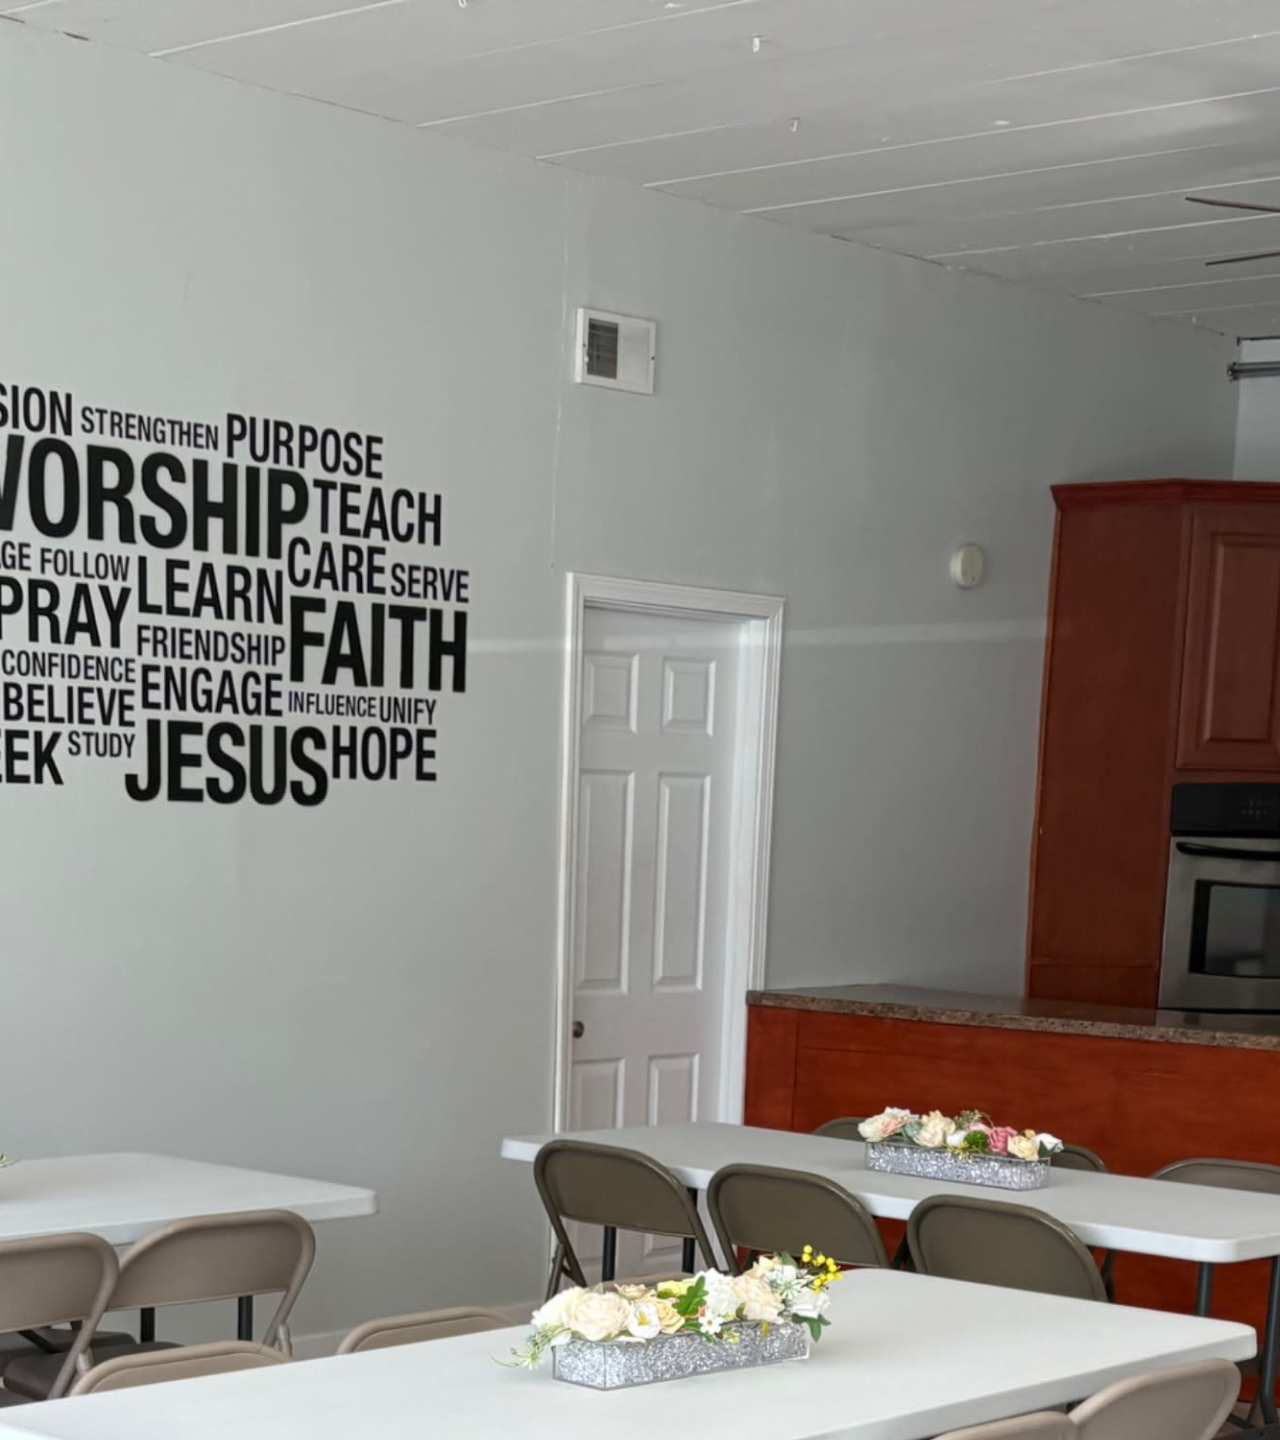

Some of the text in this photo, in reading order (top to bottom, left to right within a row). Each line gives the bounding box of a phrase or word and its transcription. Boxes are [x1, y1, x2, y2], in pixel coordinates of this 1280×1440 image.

[81, 406, 219, 451] STRENGTHEN
[226, 412, 384, 480] PURPOSE
[312, 478, 442, 547] TEACH
[40, 547, 130, 582] FOLLOW
[287, 536, 470, 604] CARE SERVE
[137, 555, 284, 626] LEARN
[289, 594, 468, 694] FAITH
[137, 624, 286, 667] FRIENDSHIP
[1, 649, 137, 684] CONFIDENCE
[3, 681, 136, 728] BELIEVE
[141, 663, 283, 718] ENGAGE
[288, 690, 377, 718] INFLUENCE
[379, 695, 437, 726] UNIFY
[67, 730, 136, 759] STUDY
[124, 718, 329, 807] JESUS
[331, 724, 437, 782] HOPE
